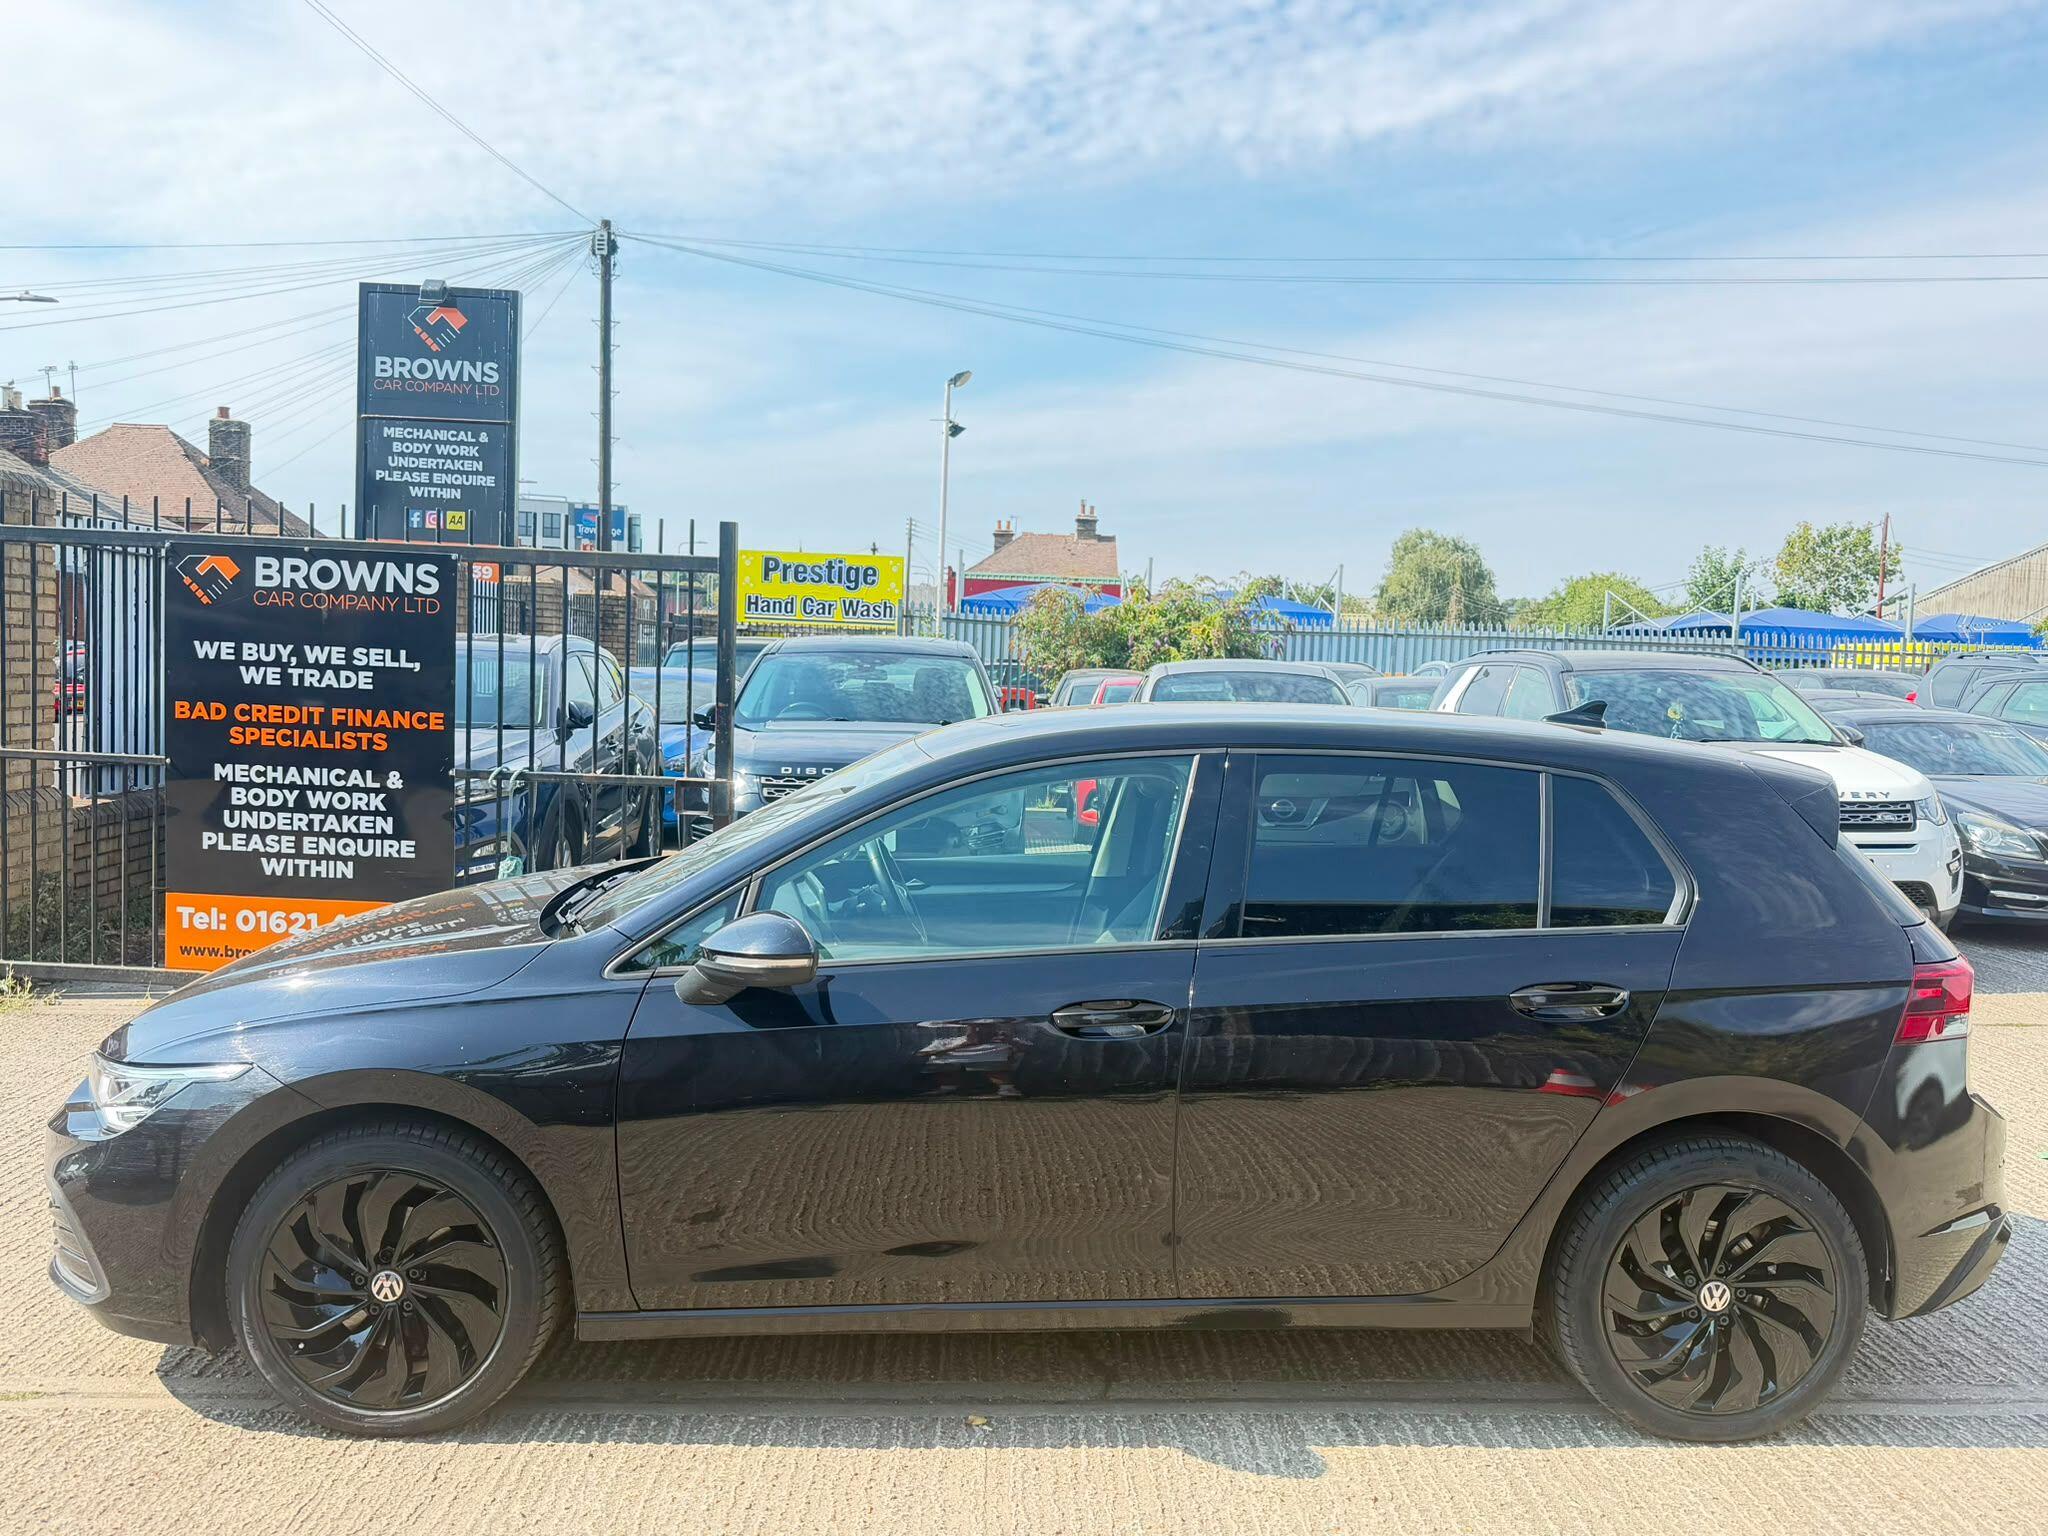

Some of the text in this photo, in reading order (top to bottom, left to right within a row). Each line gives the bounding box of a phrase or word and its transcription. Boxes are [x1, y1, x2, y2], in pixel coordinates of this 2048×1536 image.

[374, 356, 500, 384] BROWNS
[374, 379, 500, 397] CAR COMPANY LTD
[383, 426, 489, 443] MECHANICAL &
[392, 441, 480, 457] BODY WORK
[388, 455, 483, 472] UNDERTAKEN
[375, 470, 496, 487] PLEASE ENQUIRE
[409, 485, 461, 500] WITHIN
[449, 515, 463, 526] AA
[576, 524, 623, 538] Travge
[254, 556, 440, 595] BROWNS
[761, 555, 880, 592] Prestige
[253, 589, 441, 615] CAR COMPANY LTD
[746, 593, 896, 620] Hand Car Wash
[193, 640, 421, 672] WE BUY, WE SELL,
[239, 665, 374, 690] WE TRADE
[174, 701, 445, 731] BAD CREDIT FINANCE
[228, 726, 388, 751] SPECIALISTS
[213, 763, 404, 790] MECHANICAL &
[230, 786, 388, 812] BODY WORK
[222, 809, 394, 835] UNDERTAKEN
[201, 831, 416, 859] PLEASE ENQUIRE
[260, 857, 354, 879] WITHIN
[176, 905, 227, 931] Tel:
[179, 944, 256, 959] www.bro
